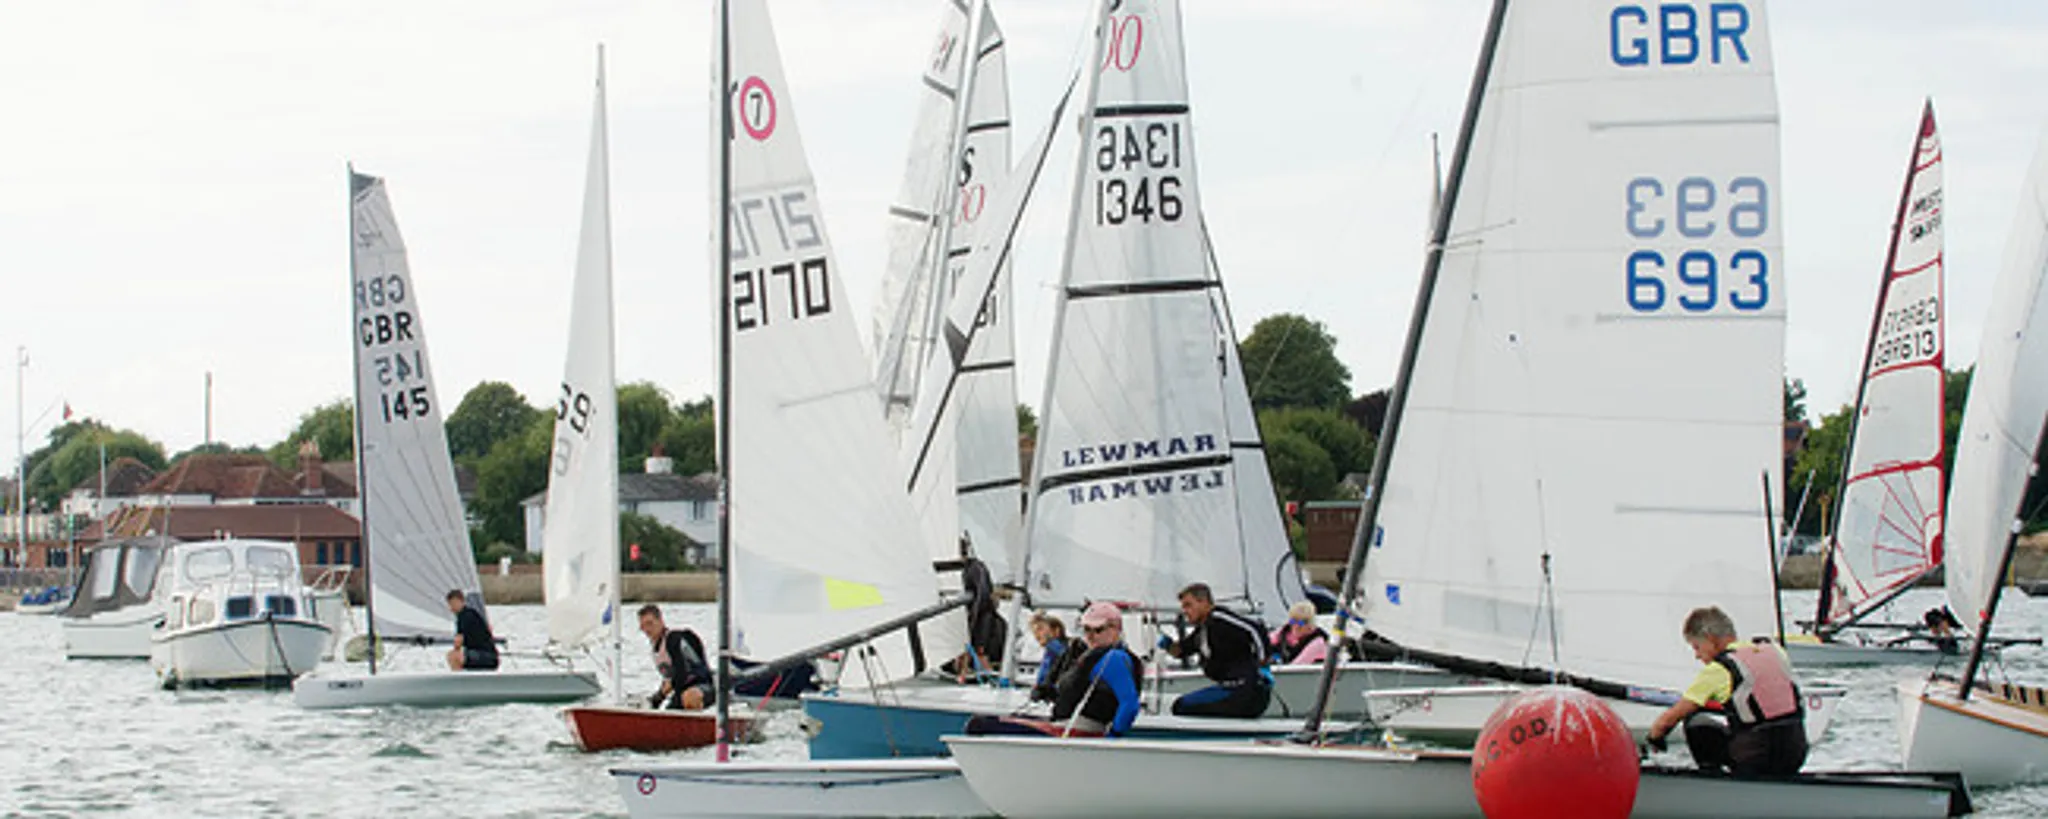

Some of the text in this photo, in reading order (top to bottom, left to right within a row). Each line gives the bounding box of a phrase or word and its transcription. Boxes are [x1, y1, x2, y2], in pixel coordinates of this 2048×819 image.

[1609, 3, 1750, 66] GBR
[750, 92, 763, 126] 7
[1096, 176, 1183, 226] 1346
[733, 257, 831, 331] 2170
[1625, 249, 1769, 312] 693
[359, 311, 414, 347] GBR
[381, 386, 430, 423] 145
[1063, 434, 1216, 468] LEWMAR
